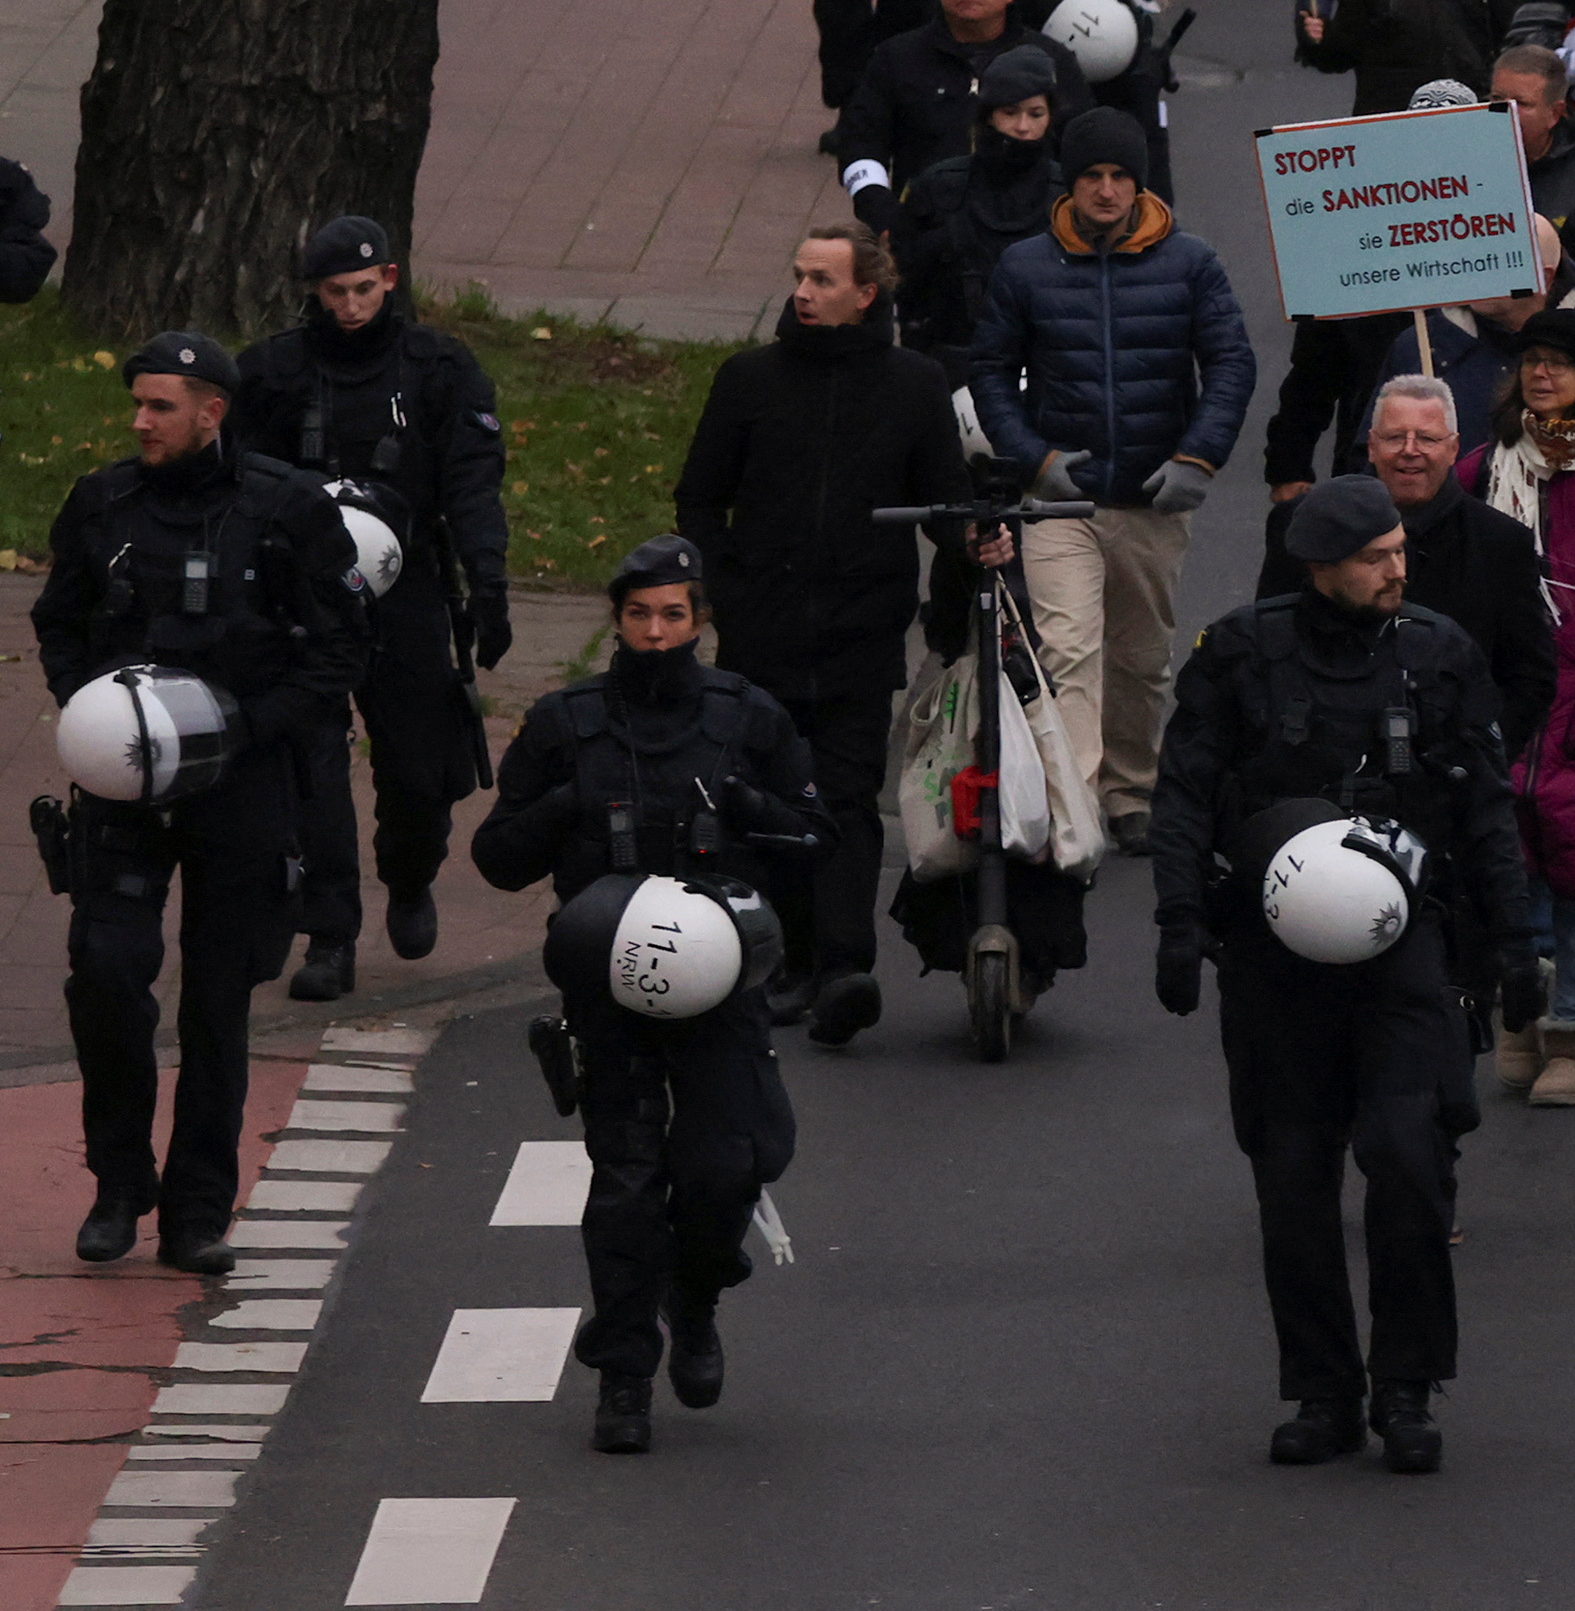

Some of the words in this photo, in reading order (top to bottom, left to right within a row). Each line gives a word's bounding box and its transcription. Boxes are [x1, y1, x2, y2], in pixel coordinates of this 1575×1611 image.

[1274, 145, 1356, 175] STOPPT
[1286, 198, 1315, 217] die
[1323, 175, 1469, 212] SANKTIONEN
[1359, 233, 1382, 250] sie
[1388, 212, 1516, 247] ZERSTÖREN
[1340, 266, 1401, 287] unsere
[1406, 253, 1499, 278] Wirtschaft
